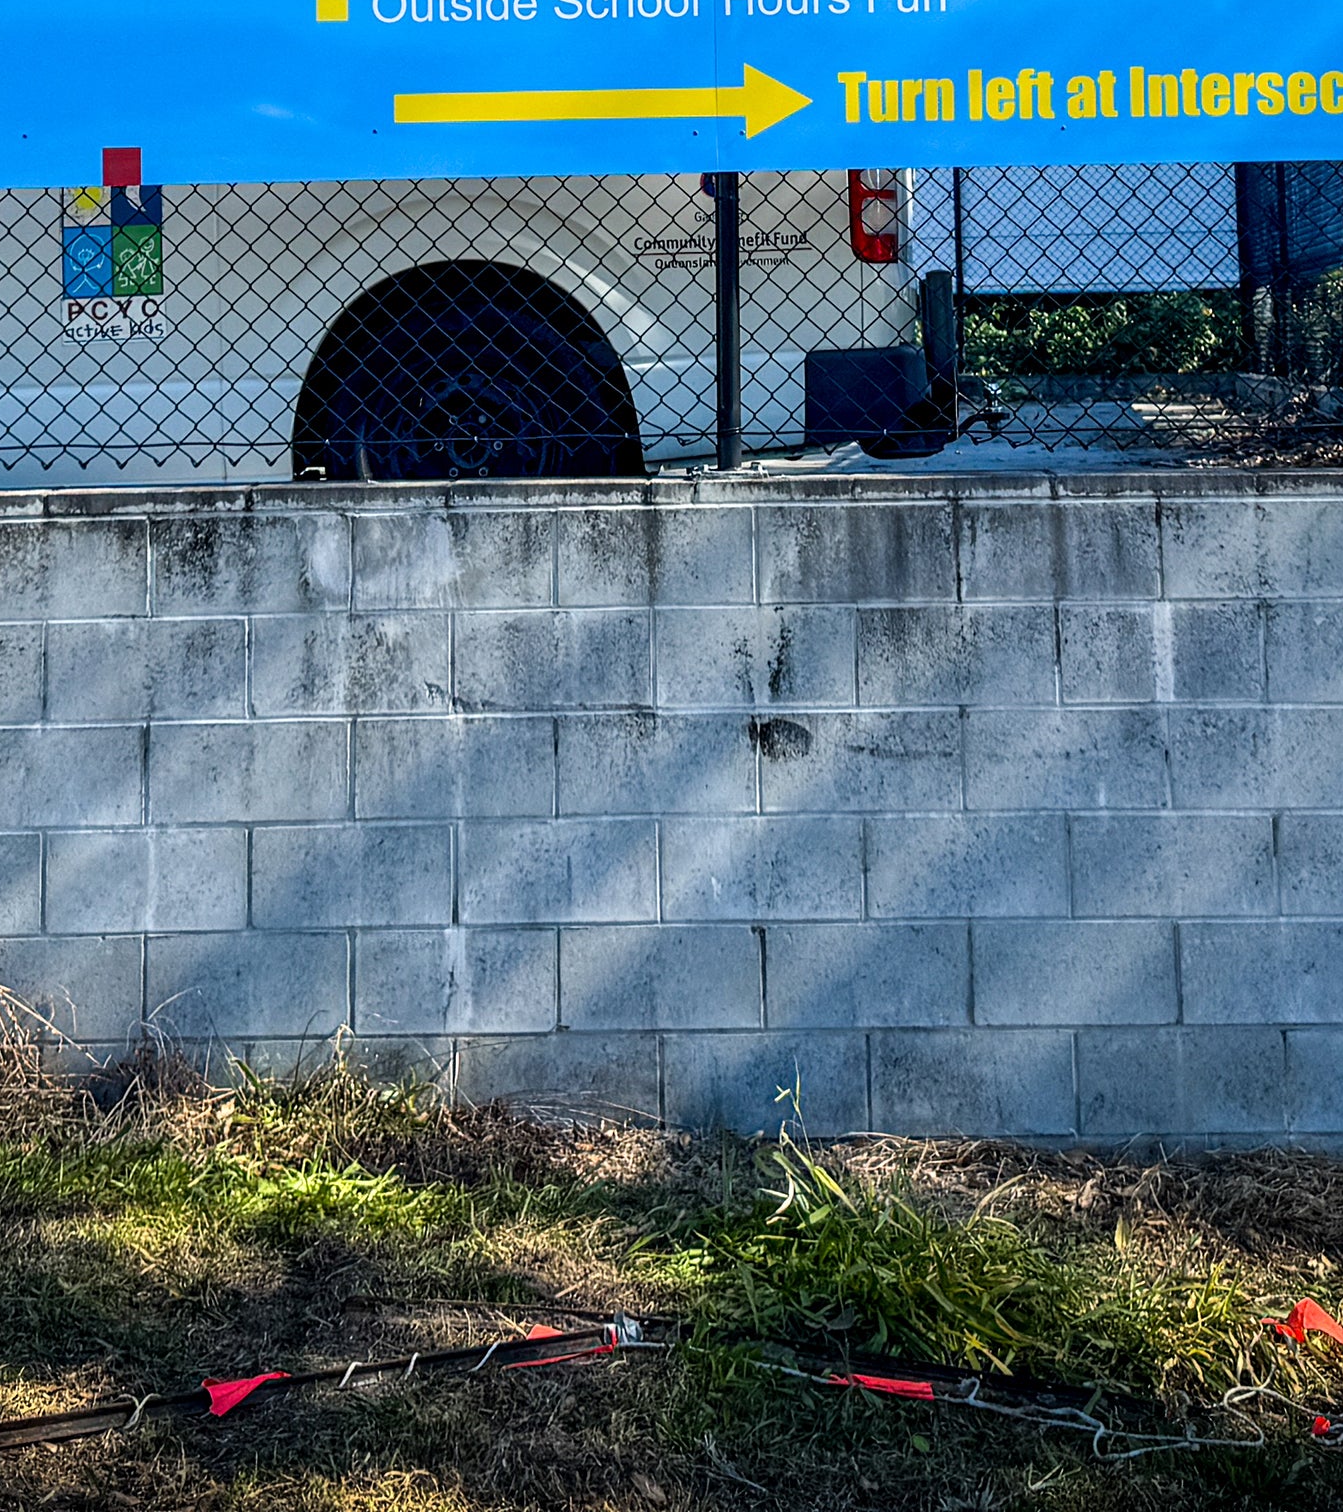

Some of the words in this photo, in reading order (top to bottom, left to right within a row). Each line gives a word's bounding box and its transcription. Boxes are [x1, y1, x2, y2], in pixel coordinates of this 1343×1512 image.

[838, 71, 955, 123] Turn
[969, 69, 1055, 121] left
[1067, 68, 1118, 119] at
[773, 230, 808, 246] Fund
[654, 256, 716, 270] Queenslan
